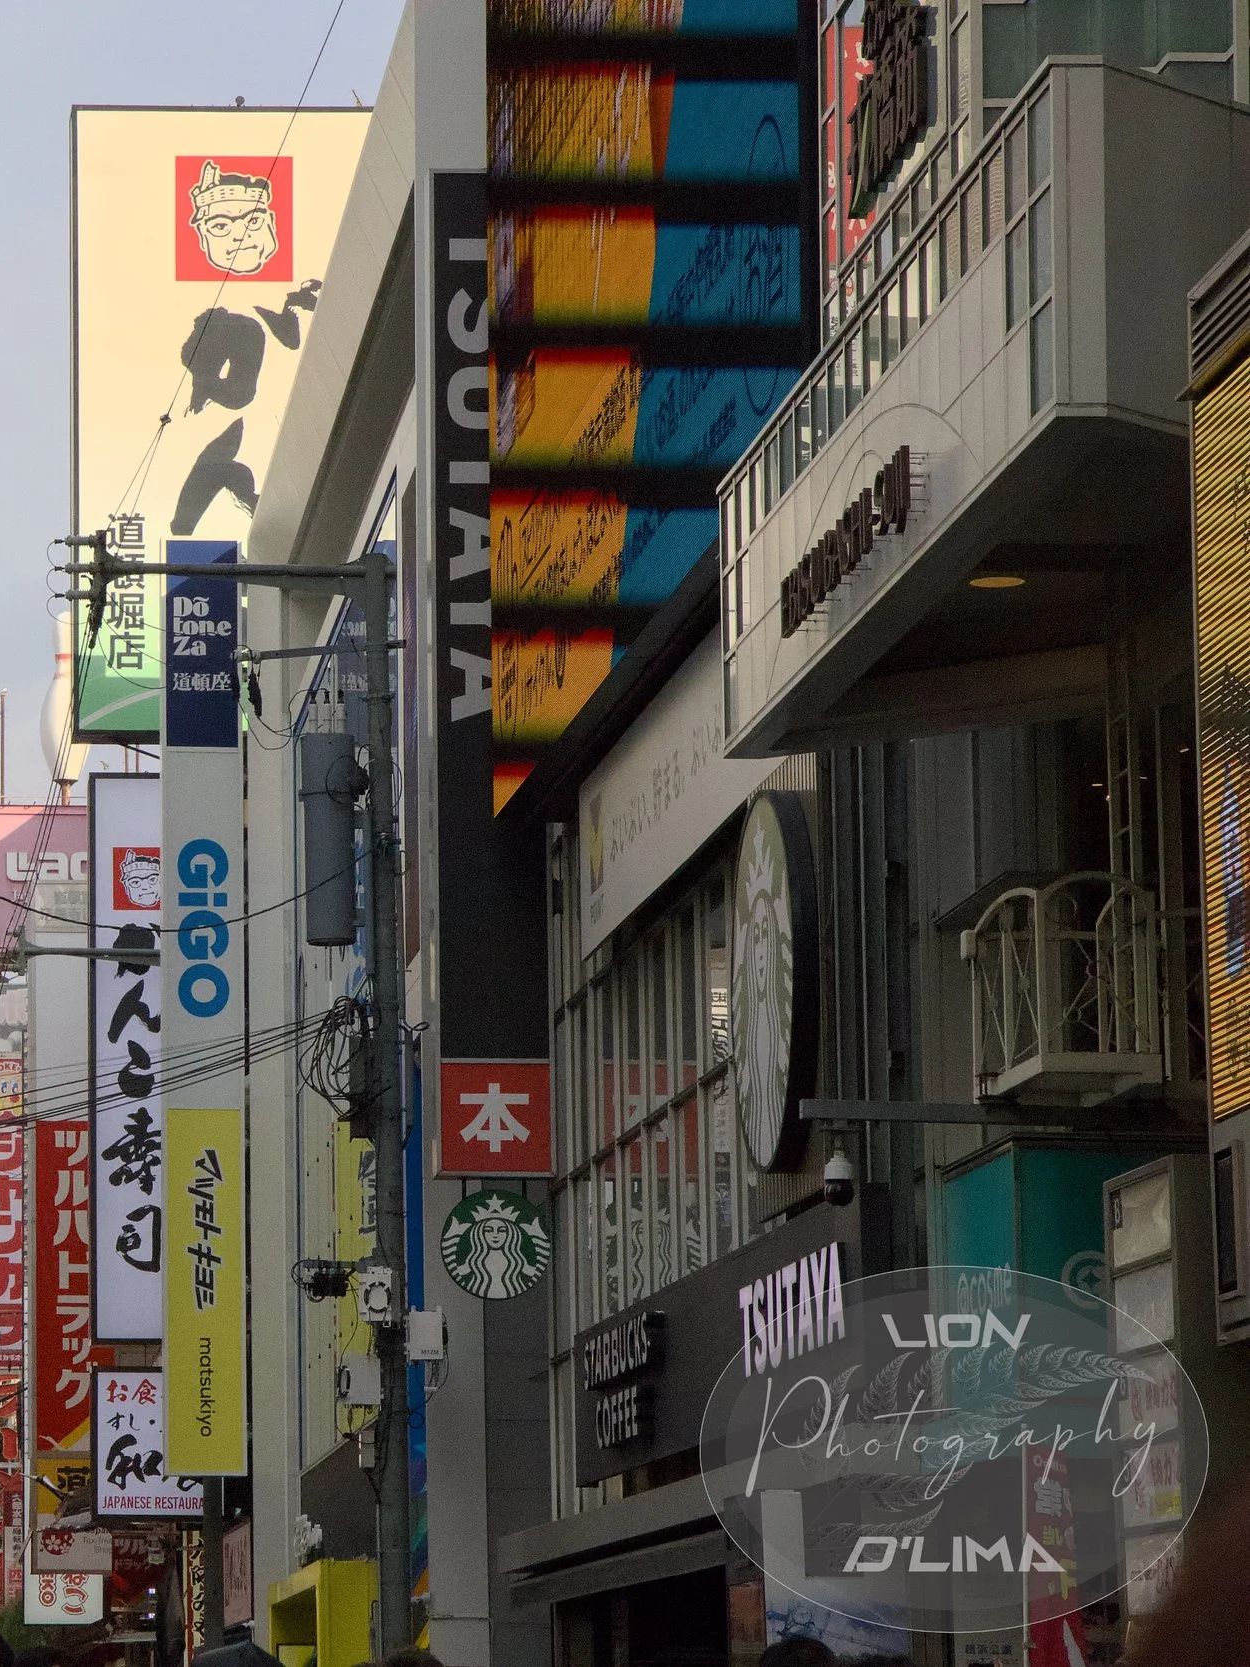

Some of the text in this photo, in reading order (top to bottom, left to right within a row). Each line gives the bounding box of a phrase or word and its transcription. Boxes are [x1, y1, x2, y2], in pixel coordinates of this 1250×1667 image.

[173, 617, 232, 636] tone
[173, 636, 207, 656] Za
[460, 1082, 531, 1153] 本
[187, 1149, 222, 1309] マツモトキヨシ
[53, 1129, 98, 1410] ツルハドラッグ
[738, 1241, 846, 1379] TSUTAYA
[197, 1337, 216, 1437] matsukiyo
[583, 1311, 649, 1391] STARBUCKS
[595, 1384, 639, 1449] COFFEE
[103, 1496, 152, 1509] JAPANESE
